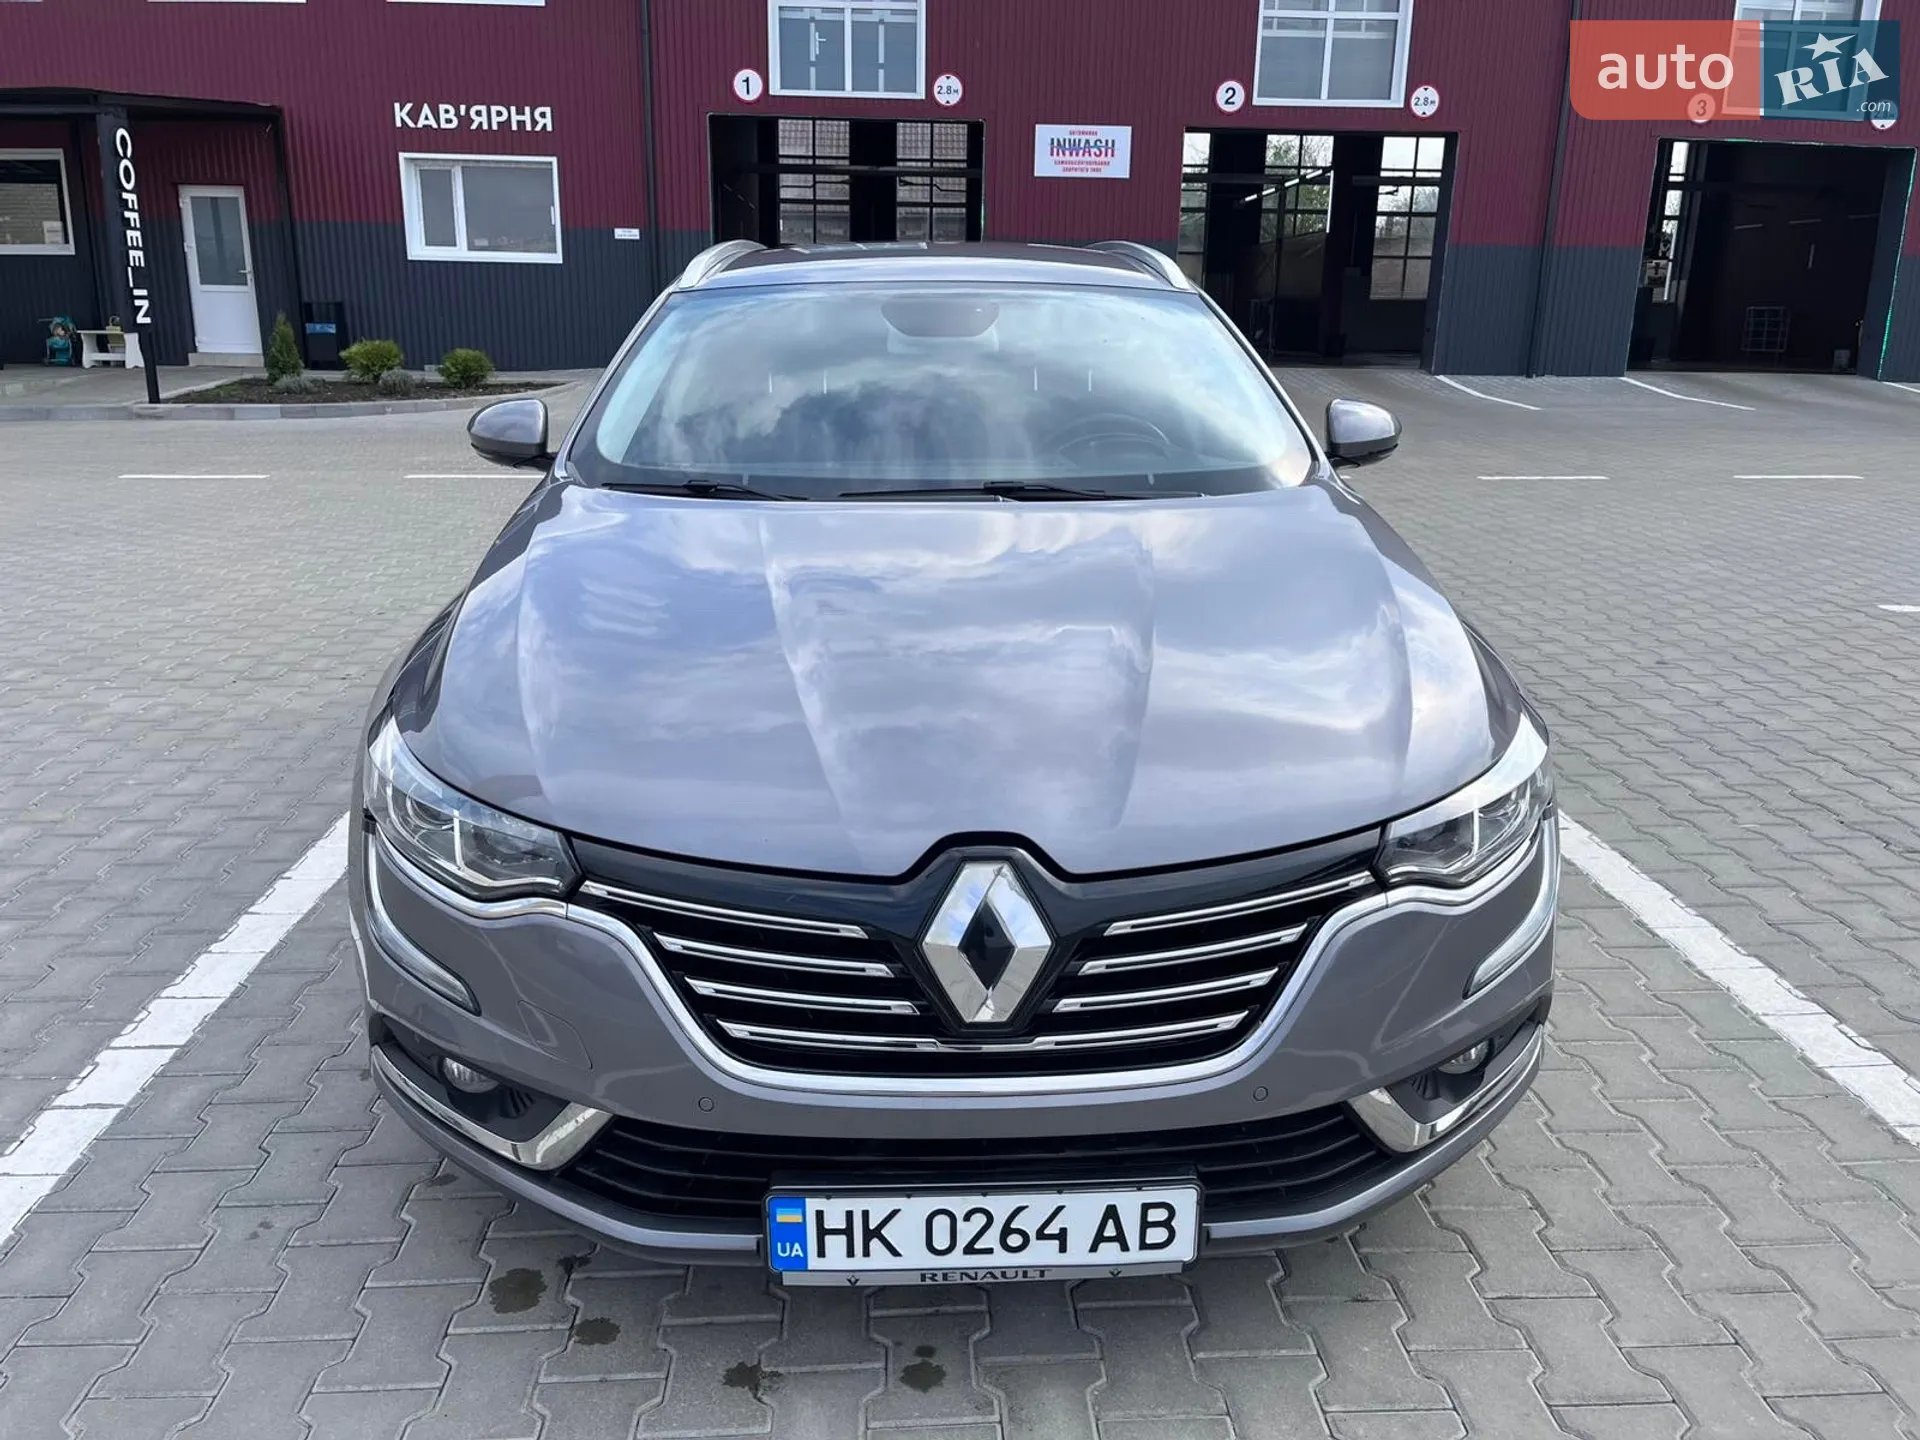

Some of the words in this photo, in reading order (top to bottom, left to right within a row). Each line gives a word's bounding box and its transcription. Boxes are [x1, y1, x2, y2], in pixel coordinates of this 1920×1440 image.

[742, 76, 750, 95] 1
[1224, 87, 1236, 105] 2
[393, 102, 553, 132] КАВ'ЯРНЯ
[1695, 99, 1707, 117] 3
[1049, 137, 1116, 158] INWASH
[815, 1208, 903, 1259] HK
[924, 1204, 1069, 1257] 0264
[1088, 1201, 1178, 1253] AB
[777, 1241, 804, 1258] UA
[919, 1268, 1053, 1283] RENAULT
